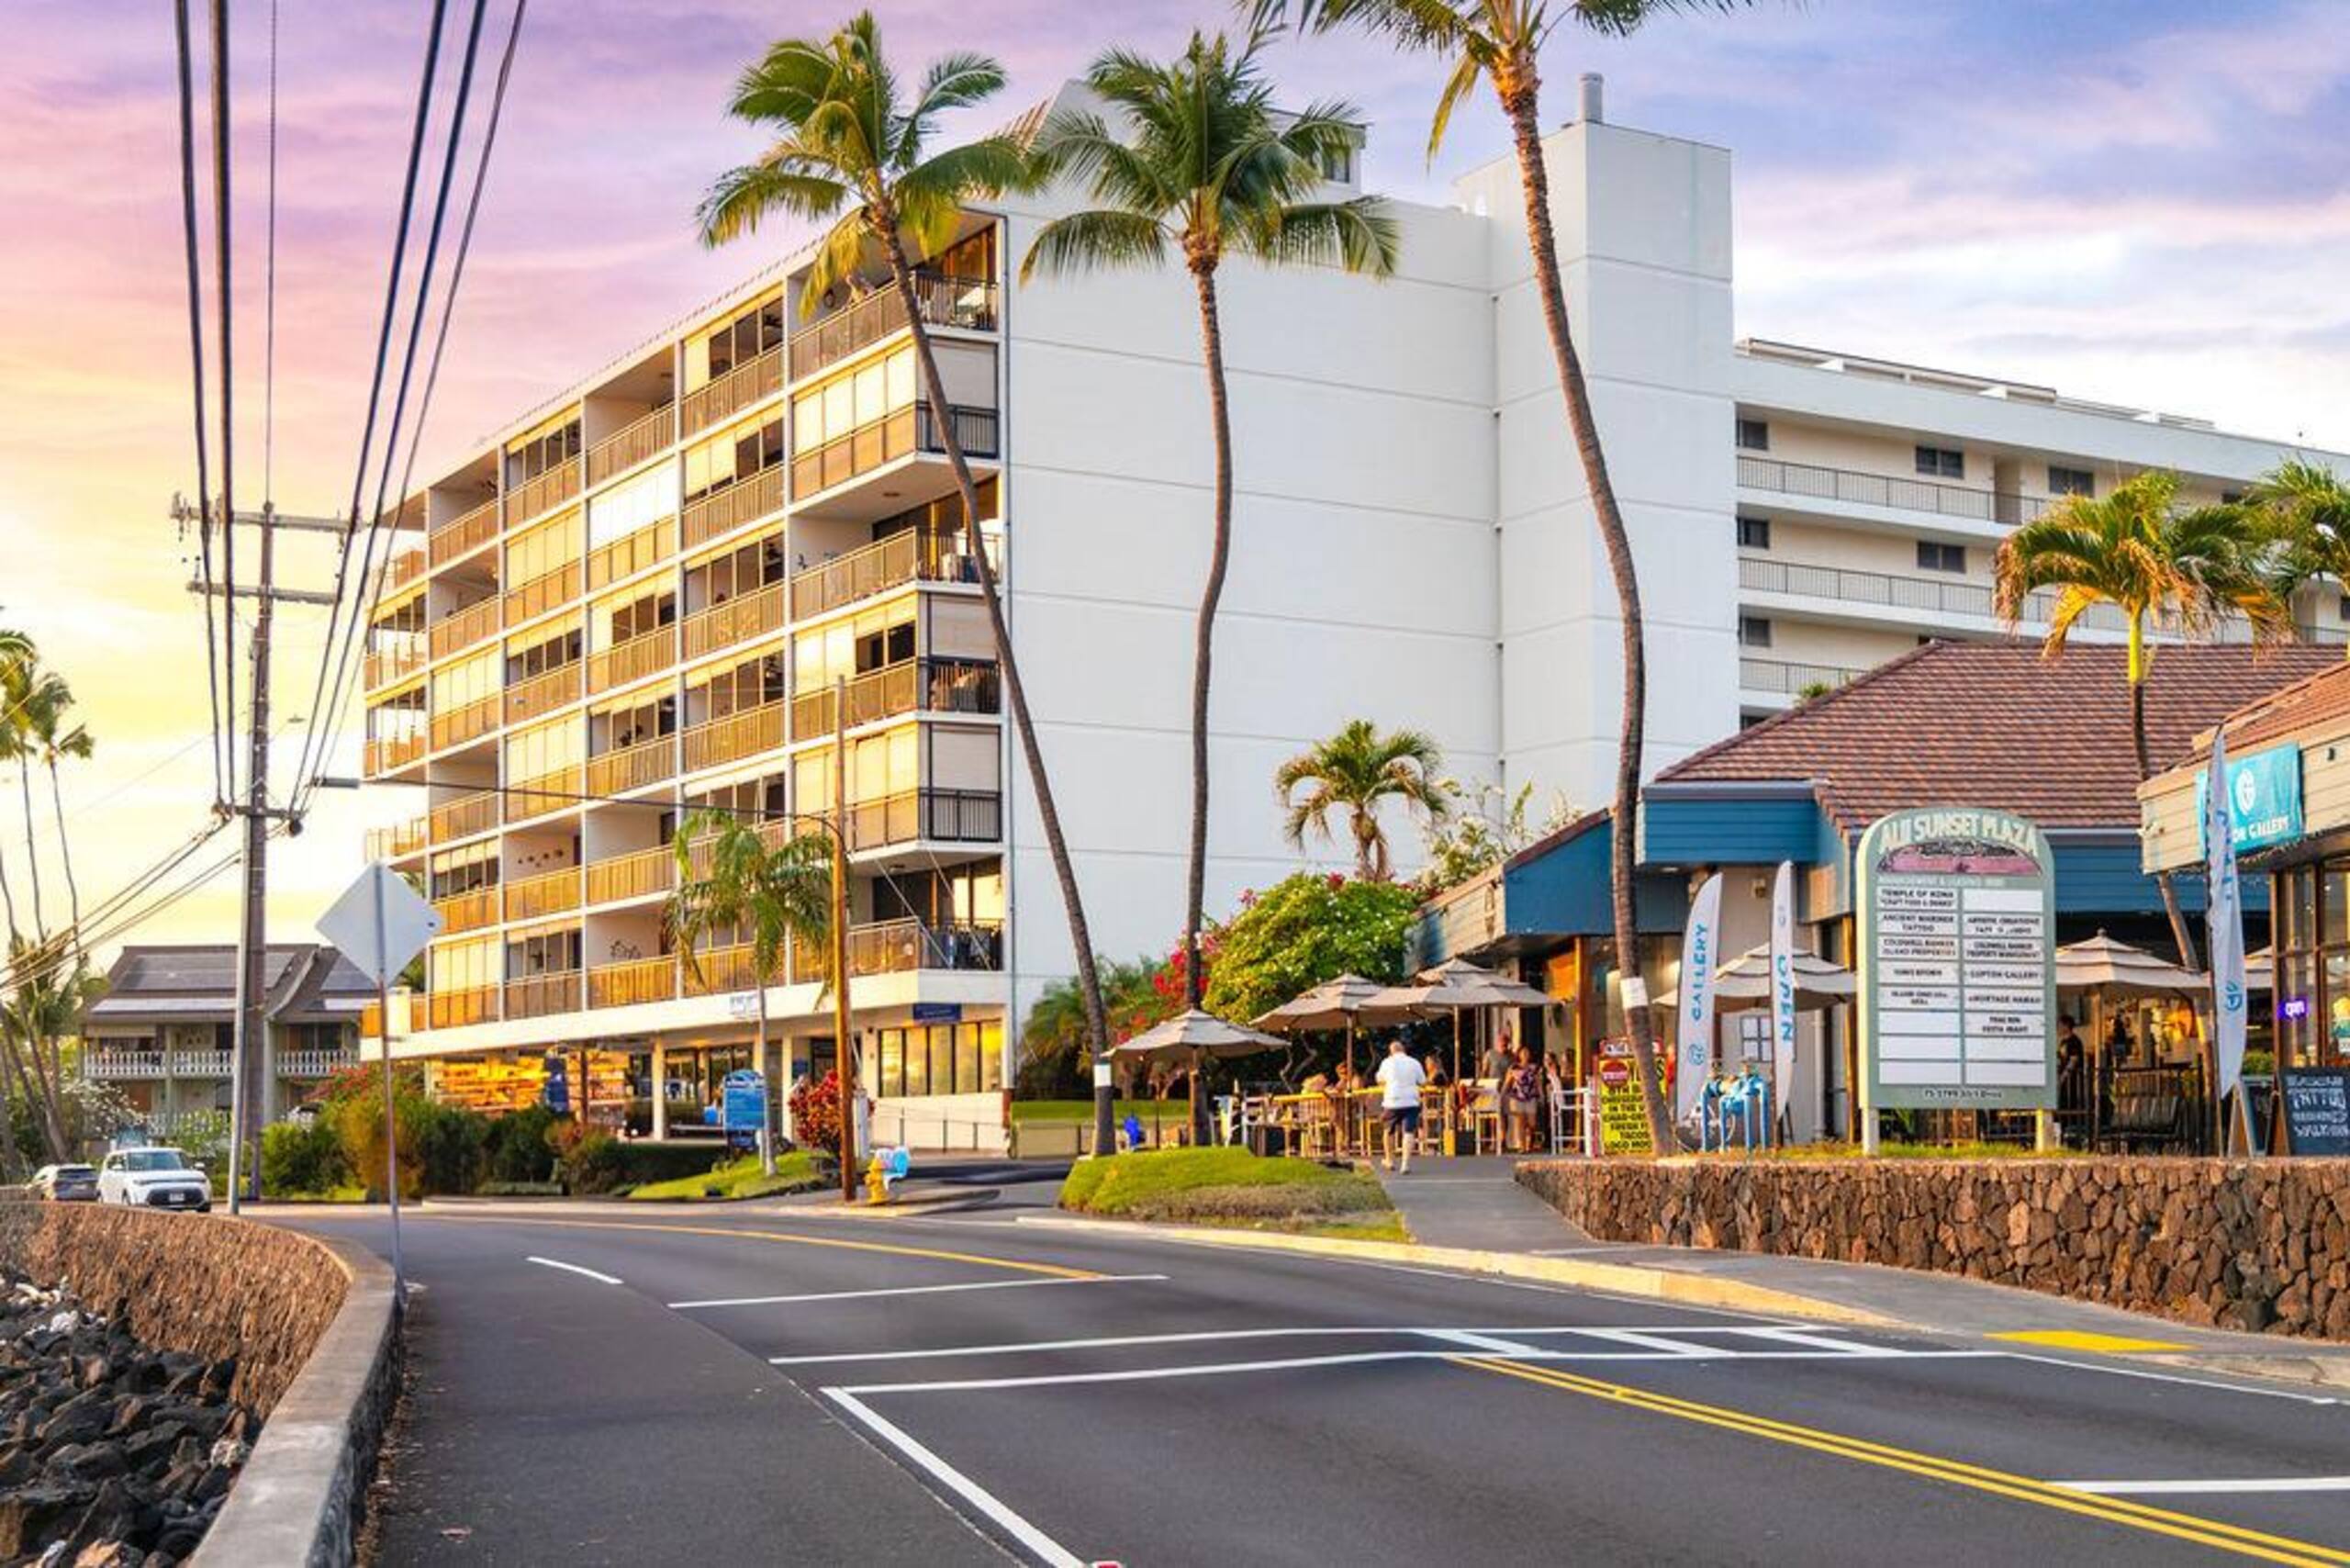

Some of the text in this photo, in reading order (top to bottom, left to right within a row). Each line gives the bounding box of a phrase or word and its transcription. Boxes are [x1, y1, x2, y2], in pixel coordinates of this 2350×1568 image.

[1913, 812, 1980, 842] SUNSET
[1982, 814, 2039, 857] PLAZA
[1882, 889, 1915, 898] TEMPLE
[1916, 890, 1928, 898] OF
[1902, 924, 1935, 933] TATTOO
[1884, 938, 1923, 946] COLDWELL
[1693, 923, 1710, 1022] GALLERY
[2004, 970, 2040, 979] GALLERY
